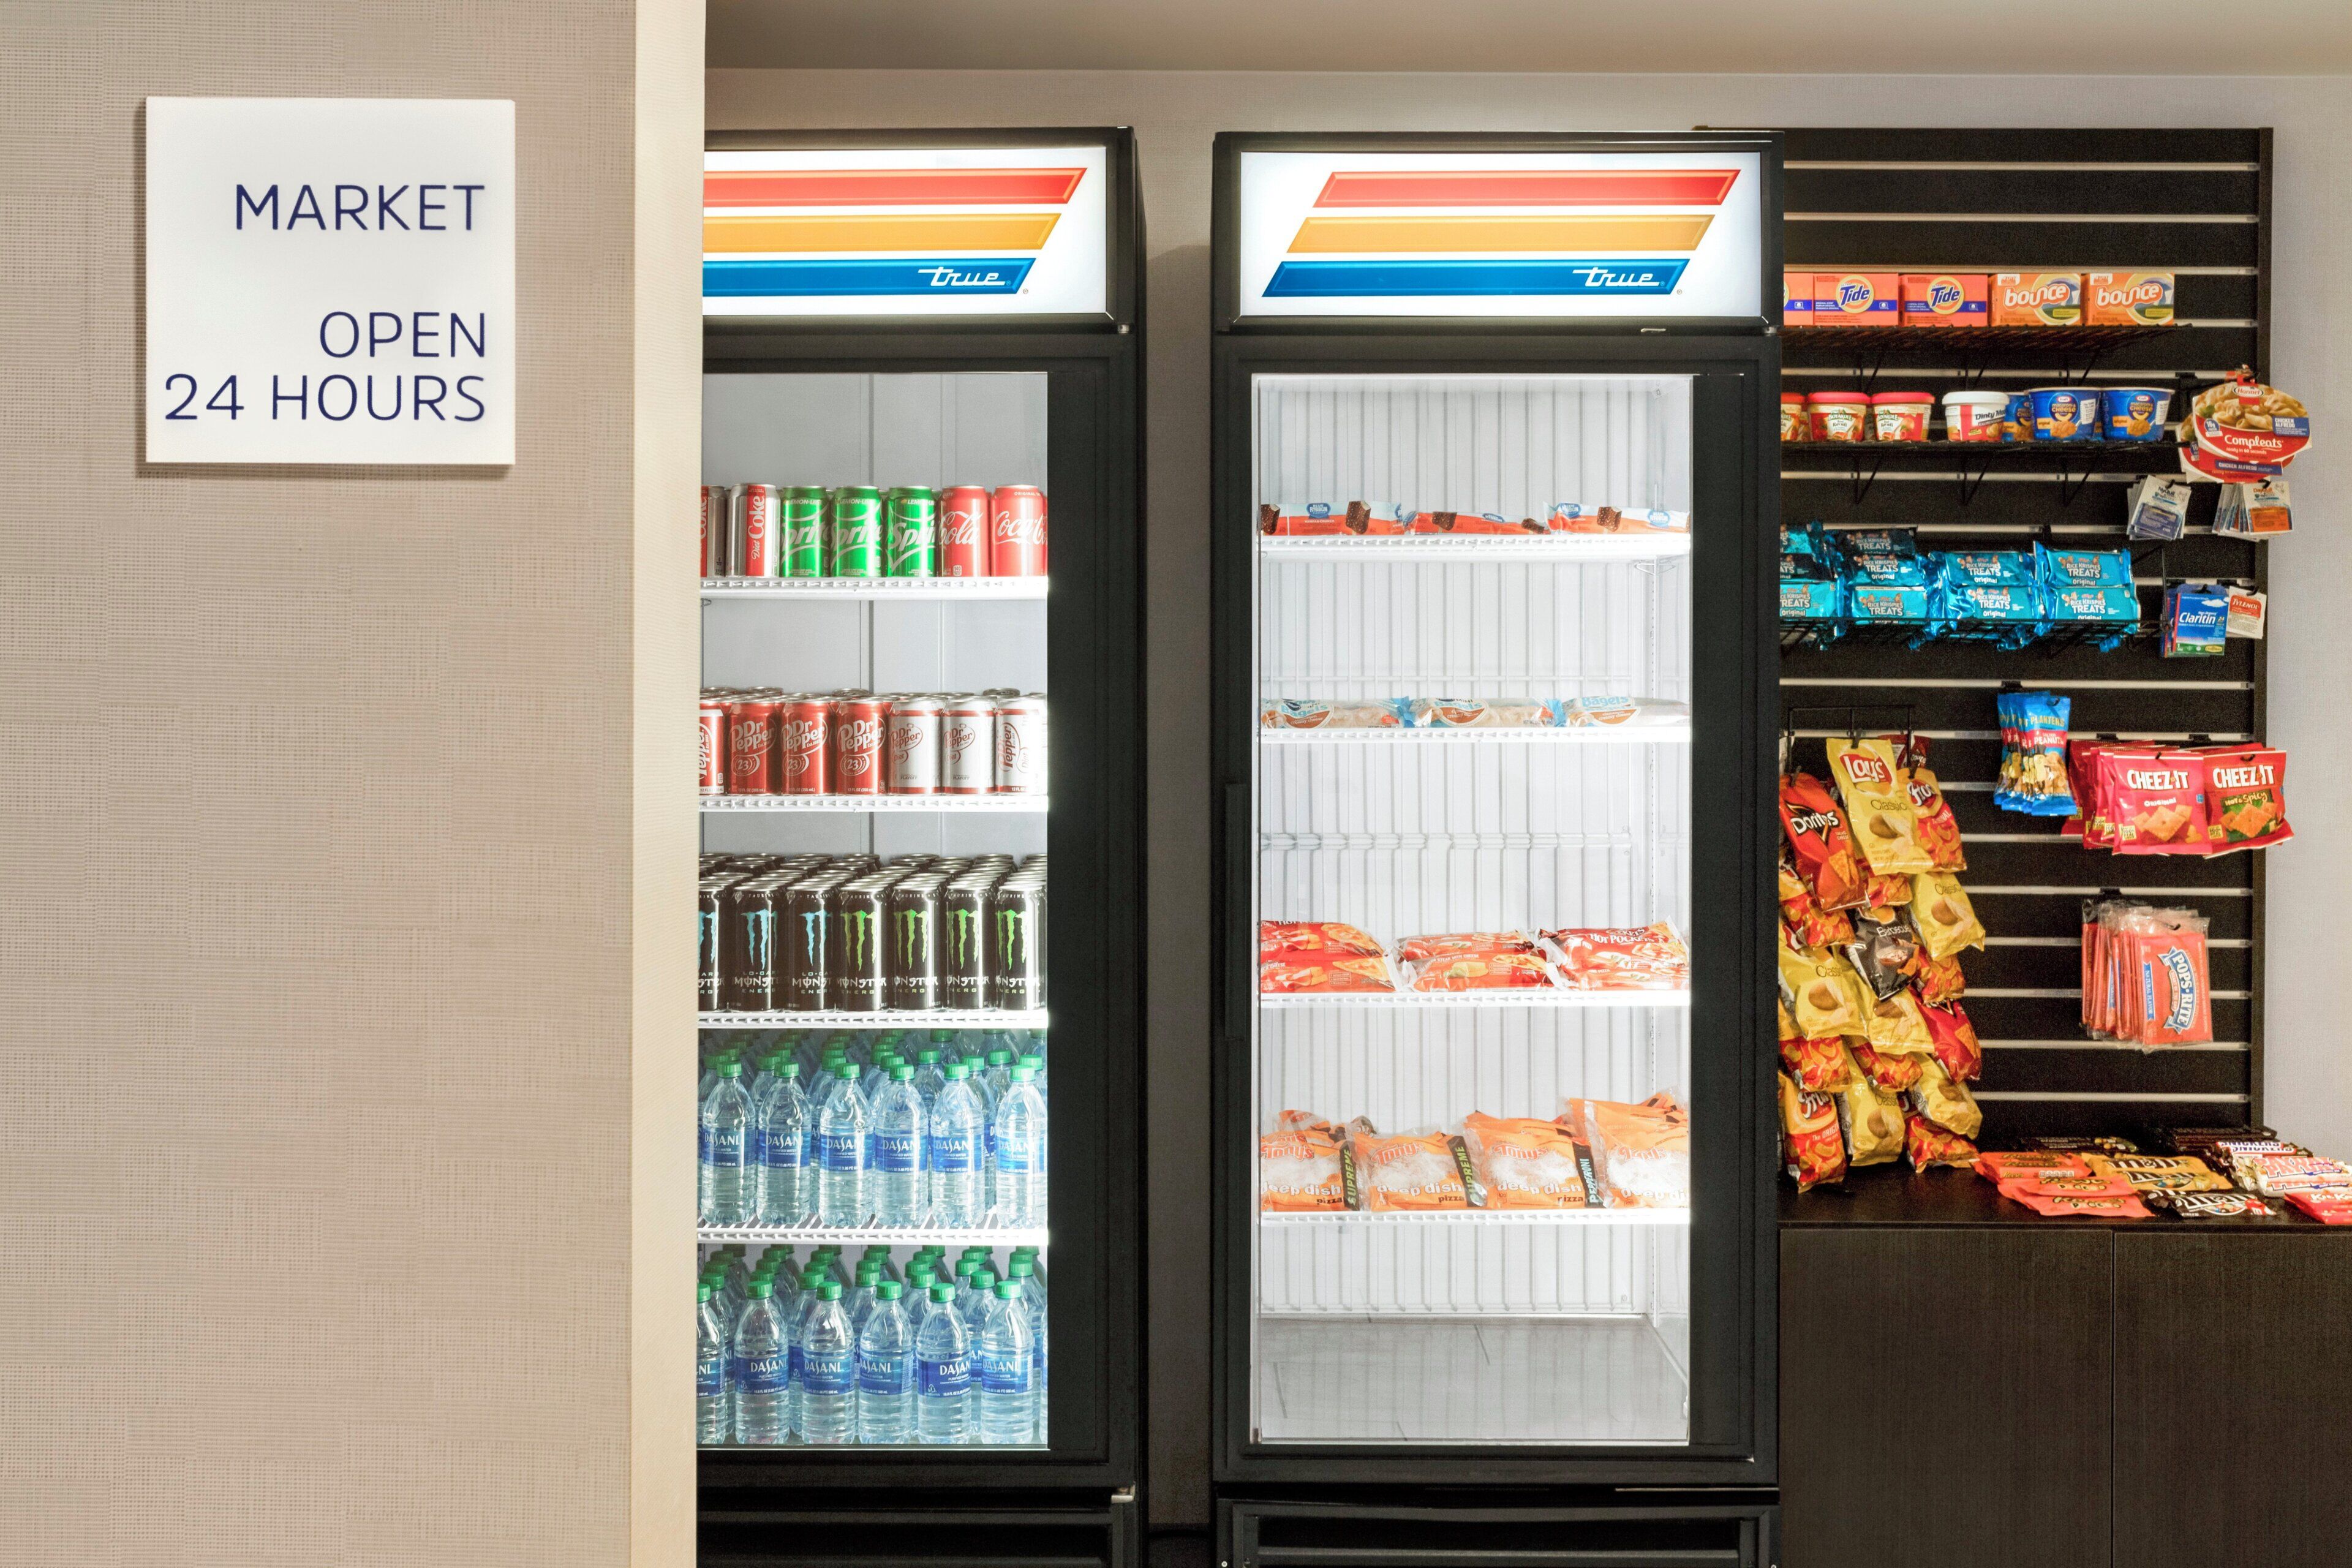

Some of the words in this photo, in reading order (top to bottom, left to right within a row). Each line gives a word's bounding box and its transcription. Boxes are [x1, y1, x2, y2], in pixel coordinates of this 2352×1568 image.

[236, 184, 485, 230] MARKET
[918, 266, 1006, 287] true
[1572, 266, 1660, 287] true
[1839, 283, 1871, 306] Tide
[1930, 285, 1960, 308] Tide
[2004, 285, 2067, 307] bounce
[2097, 285, 2160, 307] bounce
[319, 311, 485, 358] OPEN
[165, 373, 244, 420] 24
[272, 374, 485, 422] HOURS
[1975, 412, 1995, 421] Dinty
[2224, 434, 2283, 449] Compleats
[747, 495, 766, 540] Coke
[750, 541, 760, 560] Diet
[1968, 568, 2001, 576] TREATS
[2067, 568, 2101, 578] TREATS
[1781, 599, 1811, 608] TREATS
[1978, 600, 2010, 609] TREATS
[2071, 605, 2106, 614] TREATS
[2232, 598, 2260, 610] TYLENOL
[1869, 608, 1904, 616] TREATS
[2179, 612, 2216, 624] Claritin
[1581, 696, 1629, 707] Bagels
[2030, 715, 2065, 727] PLANTERS
[742, 720, 764, 739] Dr
[792, 720, 813, 737] Dr
[853, 720, 873, 737] Dr
[951, 727, 964, 736] Dr
[731, 724, 775, 753] Pepper
[782, 723, 825, 752] Pepper
[840, 723, 884, 753] Pepper
[2034, 736, 2064, 745] PEANUTS
[737, 759, 749, 770] 23
[788, 759, 798, 769] 23
[846, 759, 859, 771] 23
[1871, 799, 1907, 811] Classic
[2242, 791, 2269, 805] Spicy
[1790, 811, 1840, 835] Doritos
[827, 1135, 861, 1152] DASAN
[935, 1138, 971, 1152] DASAN
[1344, 1149, 1357, 1205] SUPREME
[1304, 1184, 1341, 1196] dish
[1425, 1182, 1463, 1194] dish
[1544, 1182, 1582, 1195] dish
[1317, 1197, 1343, 1205] pizza
[750, 1359, 788, 1374] DASANI
[805, 1360, 841, 1374] DASANI
[859, 1358, 891, 1373] DASANI
[940, 1360, 970, 1376] DASAN
